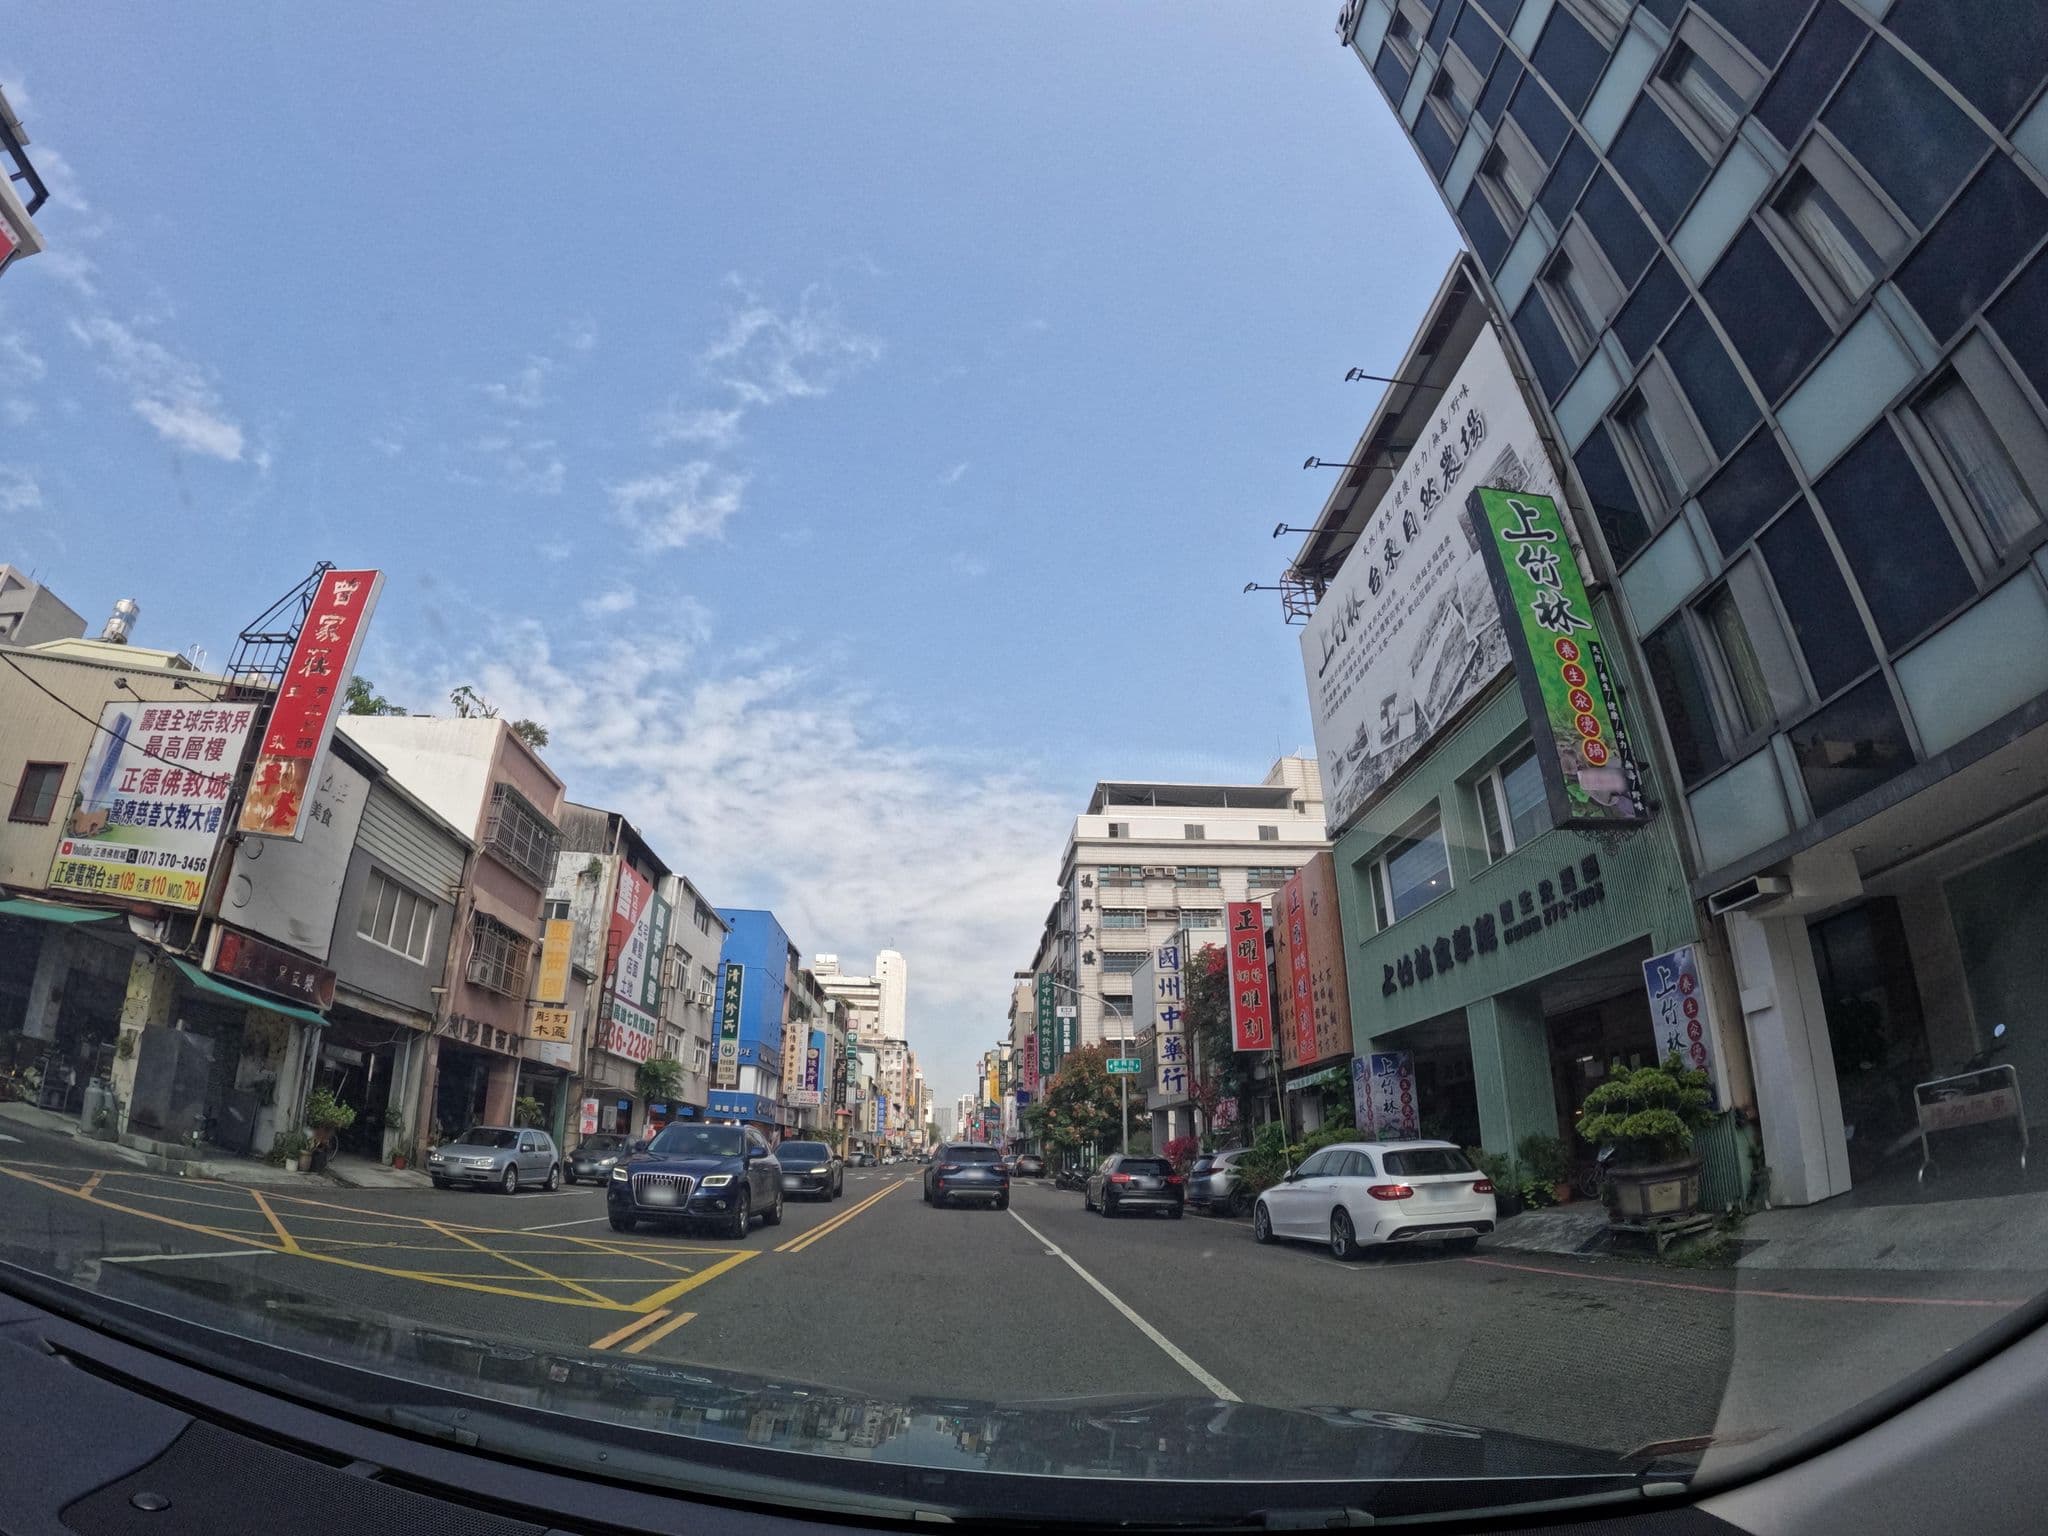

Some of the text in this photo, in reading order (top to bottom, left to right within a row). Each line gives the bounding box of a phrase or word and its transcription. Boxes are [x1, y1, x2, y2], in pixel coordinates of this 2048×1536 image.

[1502, 499, 1593, 633] 上竹林
[140, 709, 250, 735] 籌建全球宗教界
[142, 735, 227, 762] 最高層樓
[118, 767, 231, 800] 正德佛教城
[109, 798, 222, 834] 醫療慈善文教大樓
[310, 801, 333, 829] 美食
[138, 849, 157, 866] (07)
[157, 852, 208, 873] 370-3456
[54, 861, 107, 889] 正德電視台
[119, 871, 136, 891] 109
[150, 876, 168, 896] 110
[167, 883, 183, 899] MOD
[182, 879, 201, 902] 704
[723, 967, 741, 1034] 清水診所
[1158, 945, 1188, 1094] 國州中藥行
[1655, 965, 1688, 1052] 上竹林
[1376, 1057, 1400, 1114] 上竹林
